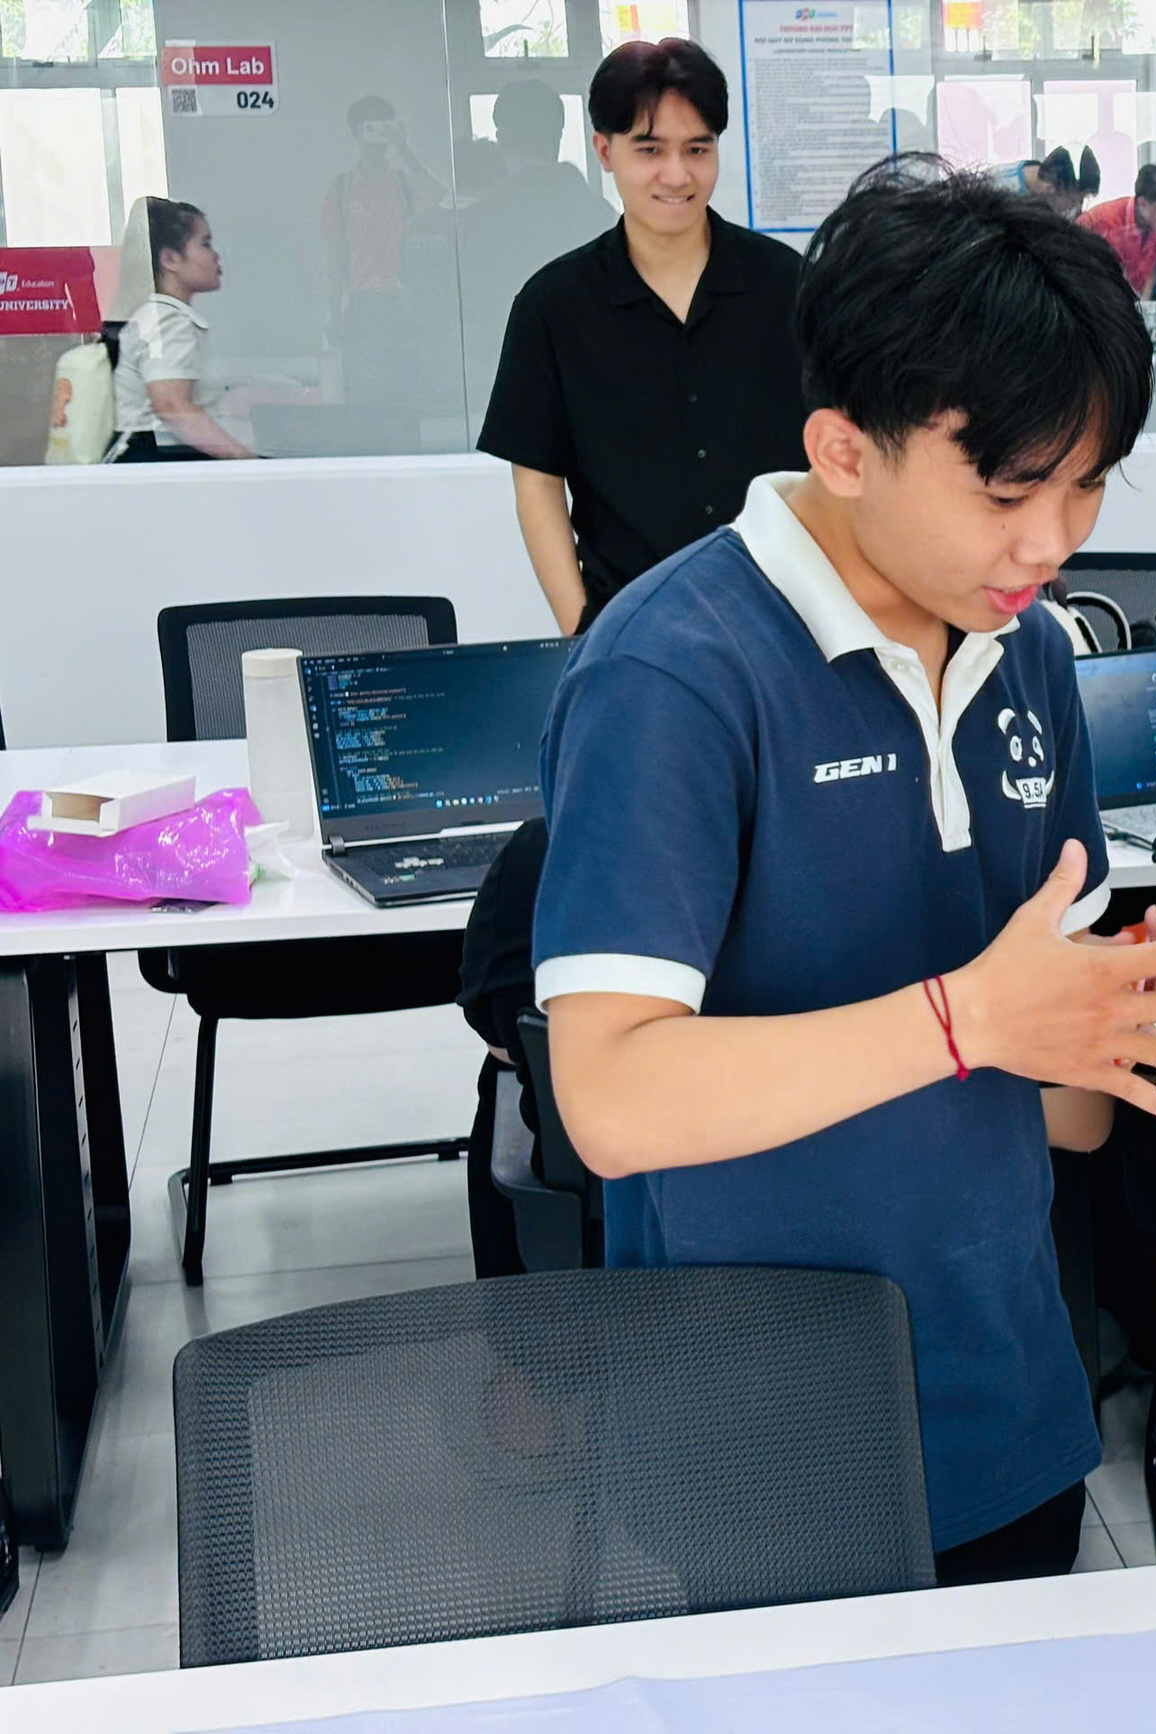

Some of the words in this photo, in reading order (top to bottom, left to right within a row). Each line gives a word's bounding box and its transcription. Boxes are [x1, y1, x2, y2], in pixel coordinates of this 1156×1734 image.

[171, 57, 220, 75] Ohm
[226, 56, 265, 75] Lab
[236, 91, 274, 109] 024
[21, 280, 55, 288] Education
[814, 755, 882, 784] GEN
